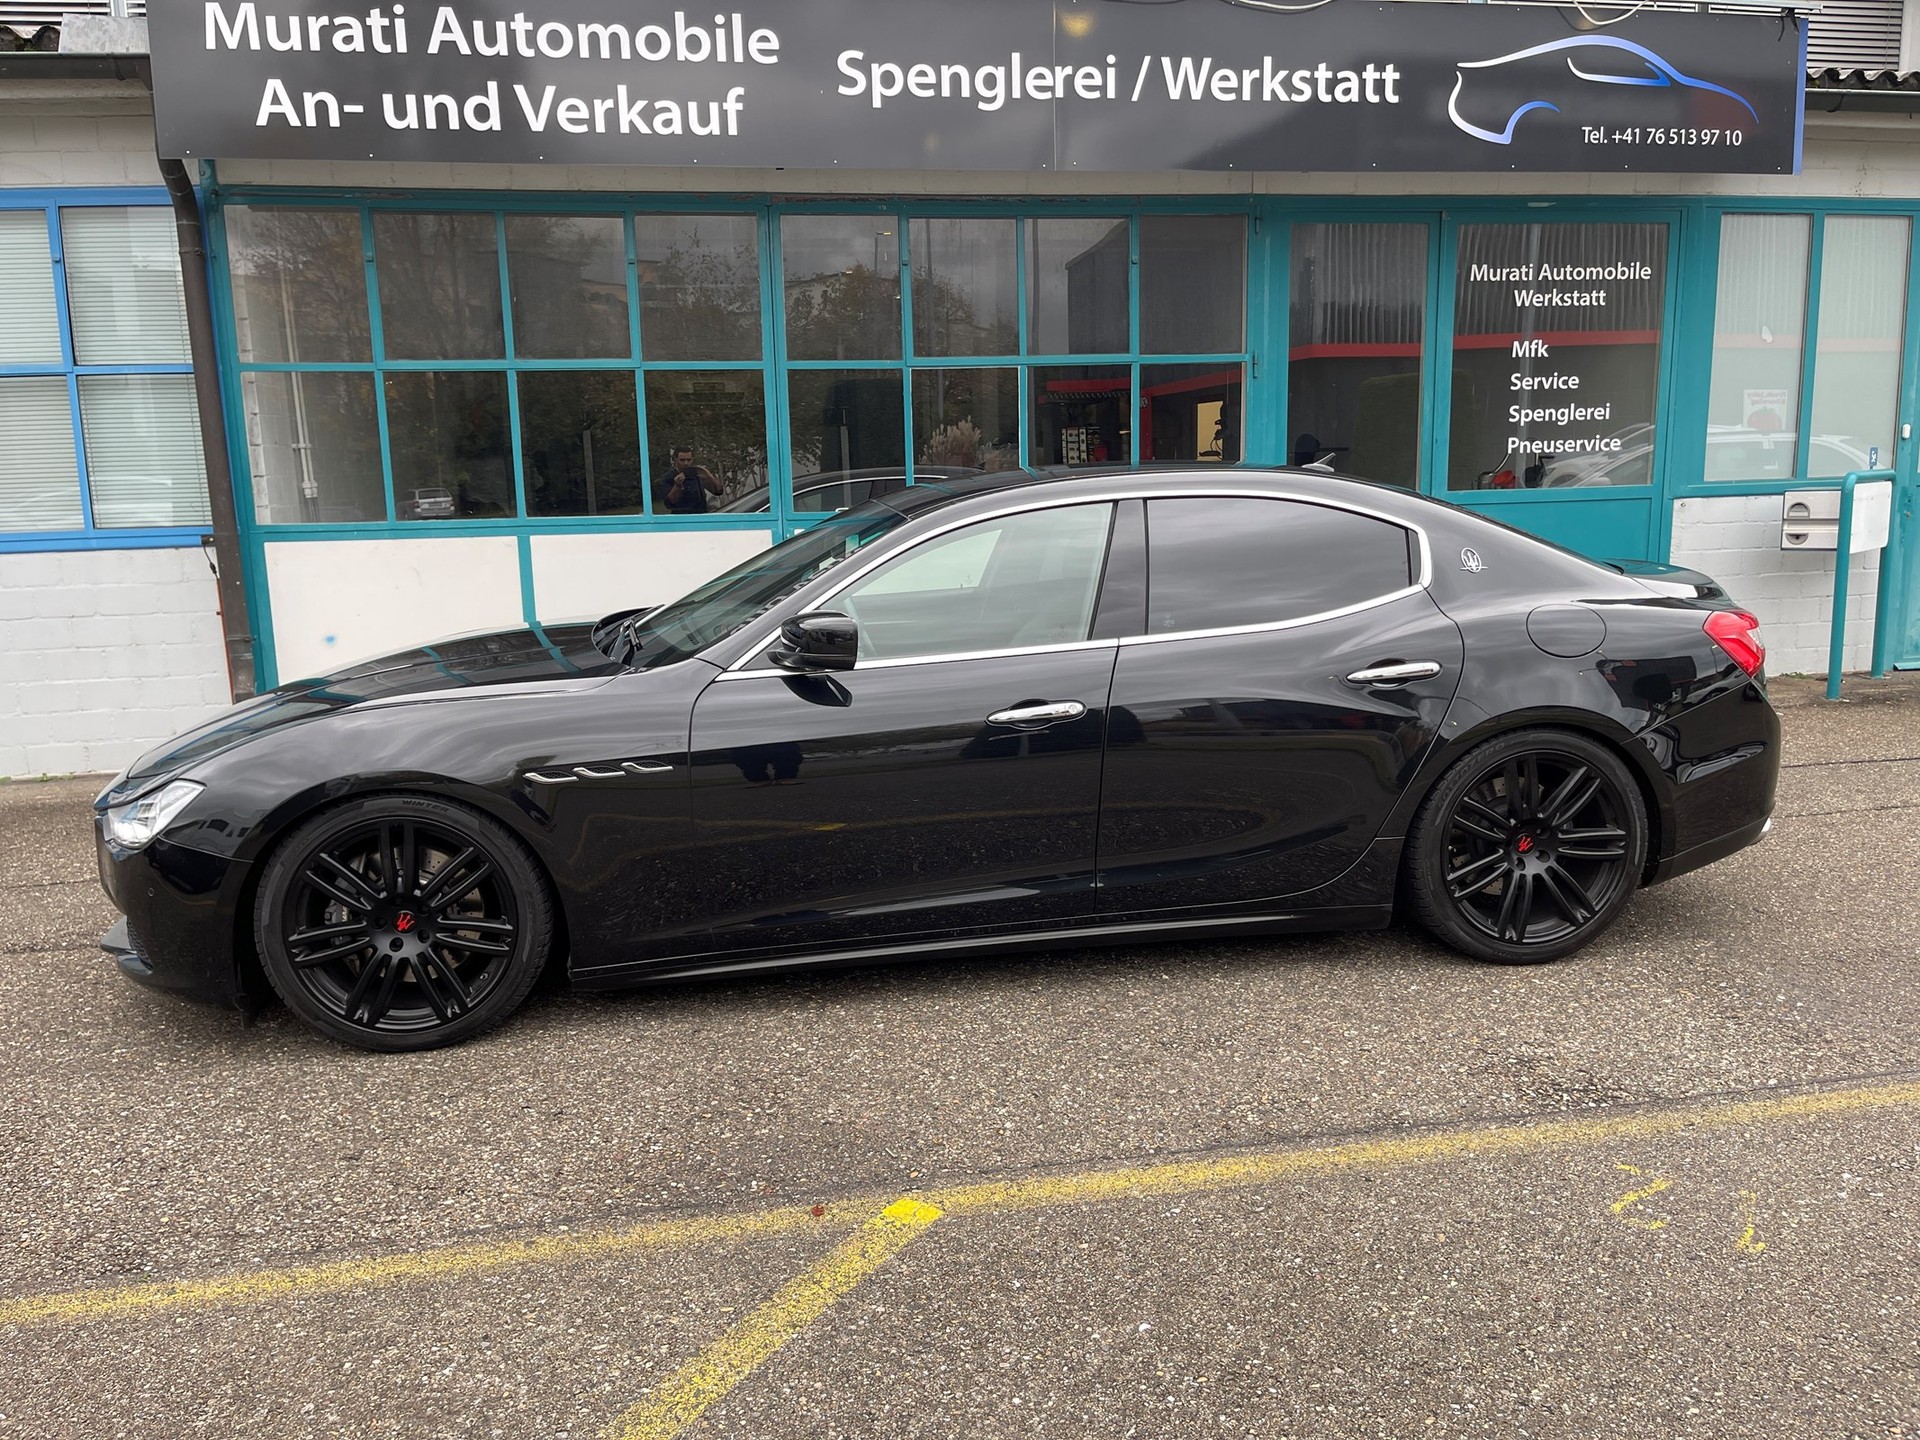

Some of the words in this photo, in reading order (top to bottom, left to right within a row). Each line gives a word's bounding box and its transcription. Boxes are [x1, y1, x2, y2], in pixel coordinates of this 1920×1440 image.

[203, 1, 408, 54] Murati
[427, 6, 781, 65] Automobile
[835, 49, 1118, 112] Spenglerei
[1130, 53, 1152, 102] /
[1160, 55, 1402, 105] Werkstatt
[255, 78, 365, 128] An-
[382, 80, 502, 132] und
[512, 84, 746, 137] Verkauf
[1581, 126, 1608, 144] Tel.
[1611, 127, 1640, 145] +41
[1646, 127, 1666, 145] 76
[1668, 128, 1698, 146] 513
[1700, 128, 1720, 146] 97
[1724, 129, 1743, 147] 10
[1469, 263, 1534, 283] Murati
[1537, 261, 1653, 281] Automobile
[1513, 288, 1607, 308] Werkstatt
[1511, 339, 1550, 359] Mfk
[1509, 371, 1580, 391] Service
[1508, 402, 1612, 427] Spenglerei
[1507, 435, 1622, 455] Pneuservice
[402, 799, 449, 813] WINTER
